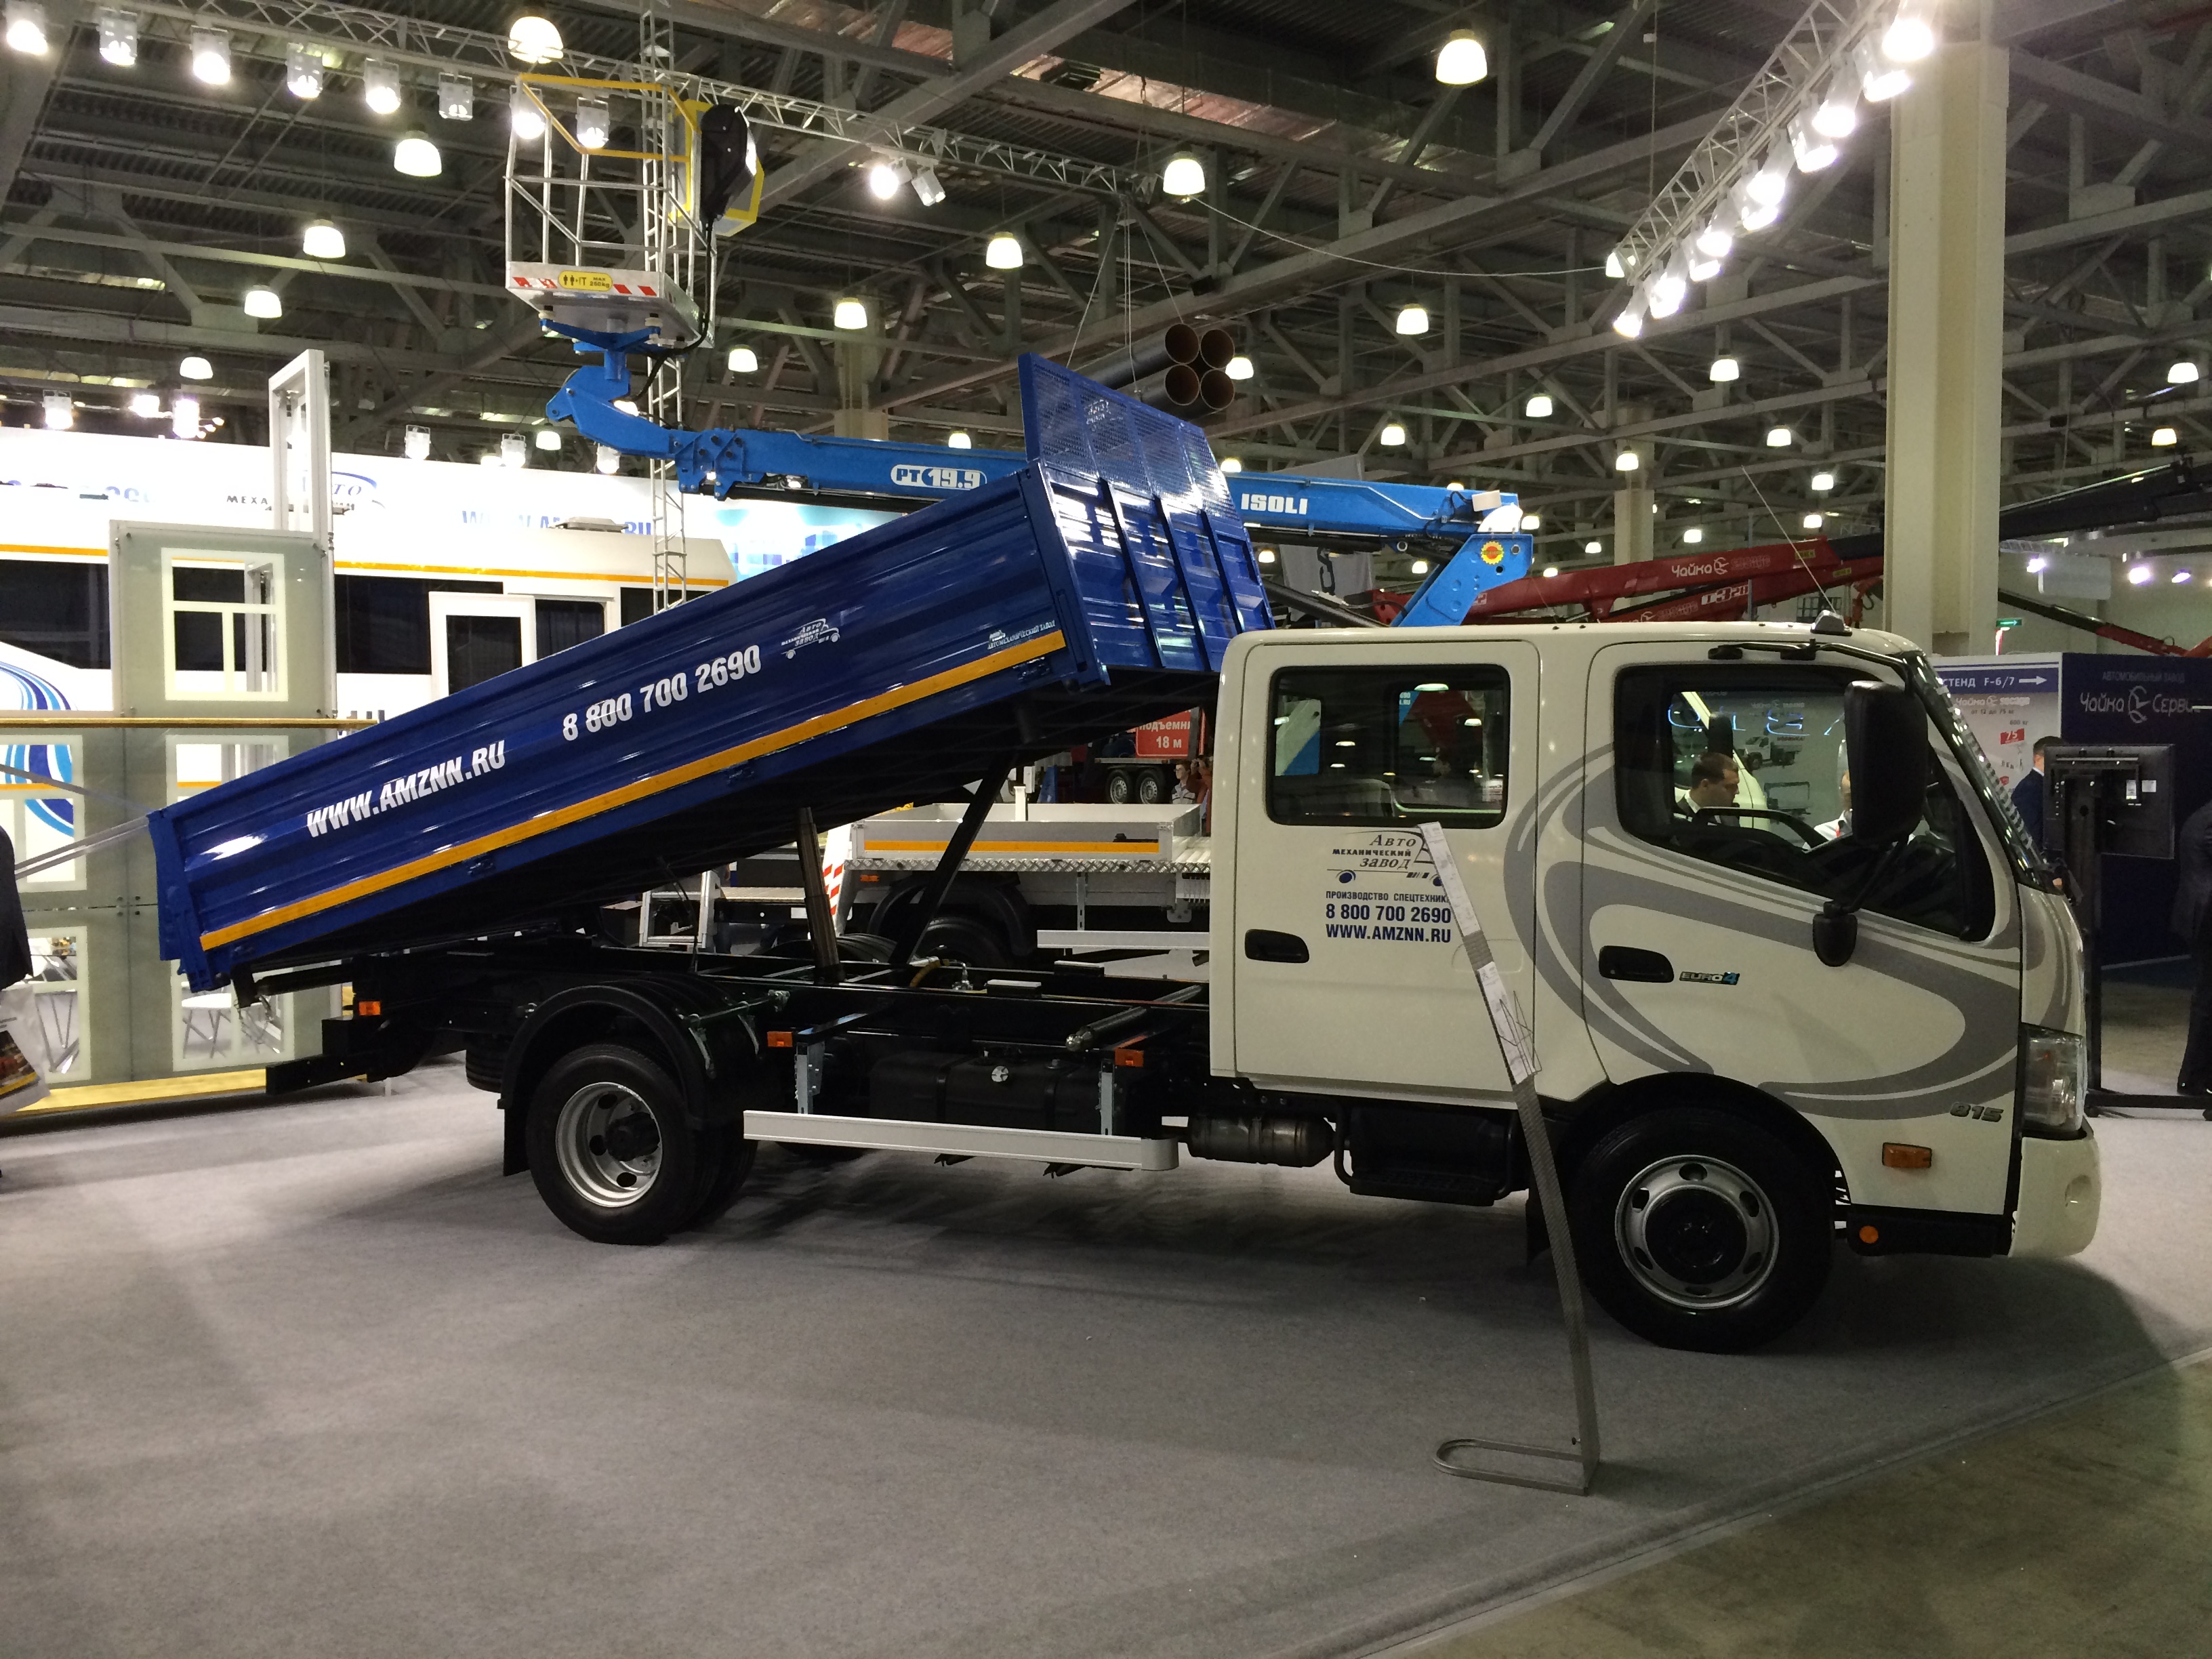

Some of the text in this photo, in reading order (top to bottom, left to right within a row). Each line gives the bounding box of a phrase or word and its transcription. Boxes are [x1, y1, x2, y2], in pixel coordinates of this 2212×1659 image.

[897, 468, 981, 489] PT 19.9
[1241, 493, 1308, 515] ISOLI
[1671, 563, 1713, 577] Чайка
[1943, 677, 2015, 689] СТЕНД F-6/7
[562, 645, 761, 741] 8 800 700 2690
[1156, 736, 1170, 748] 18
[306, 739, 506, 838] WWW.AMZNN.RU
[1326, 890, 1448, 903] ПРОИЗВОДСТВО СПЕЦТЕХНИК
[1326, 903, 1451, 923] 8 800 700 2690
[1326, 924, 1451, 943] WWW.AMZNN.RU
[1950, 1103, 2004, 1122] 815
